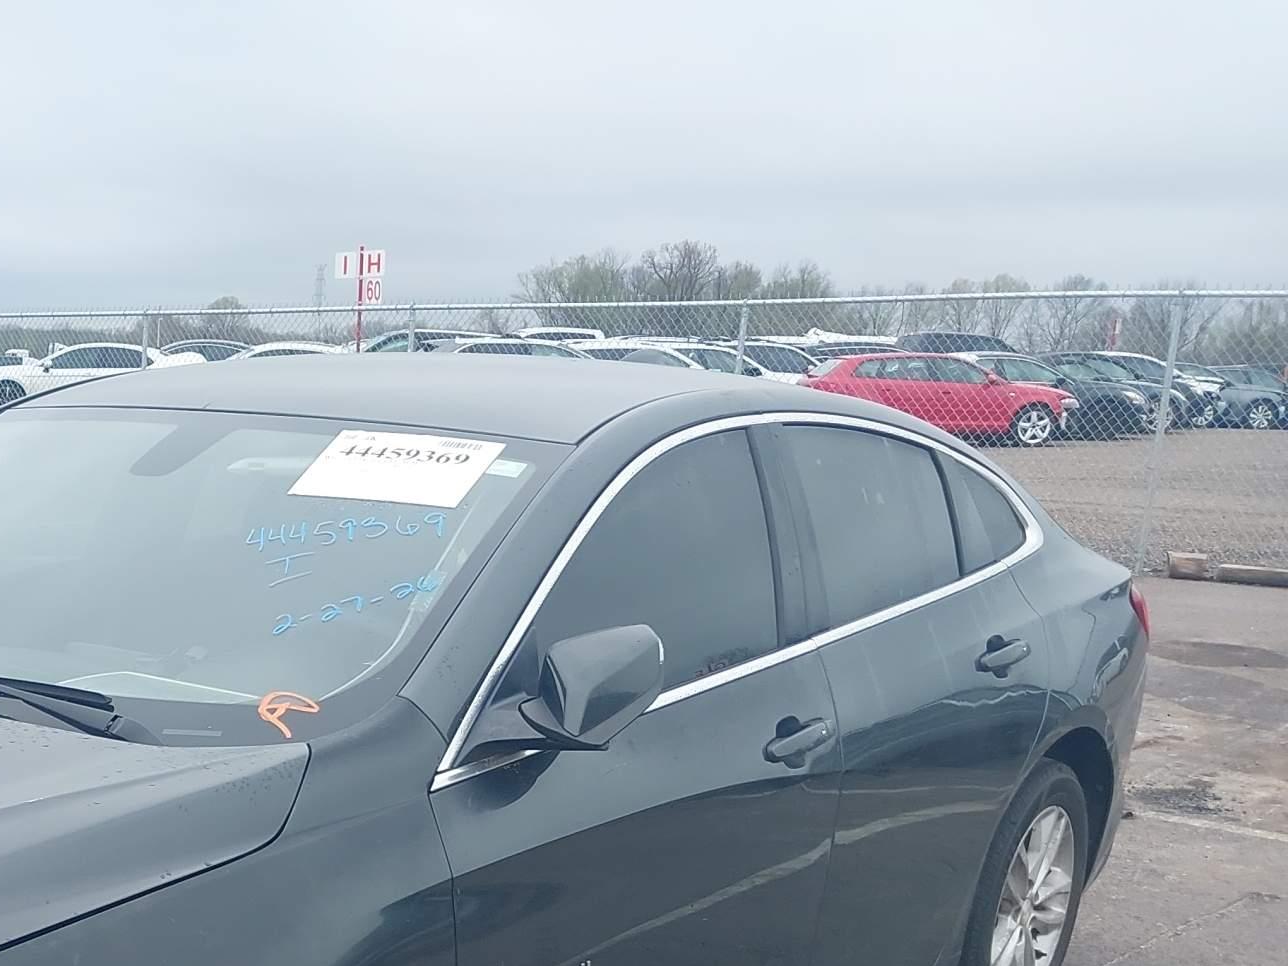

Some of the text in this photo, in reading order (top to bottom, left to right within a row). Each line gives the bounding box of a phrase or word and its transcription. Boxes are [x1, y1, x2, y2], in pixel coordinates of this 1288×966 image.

[367, 253, 381, 274] H
[366, 280, 381, 301] 60
[339, 444, 471, 465] 44459369
[245, 512, 447, 551] 44459369
